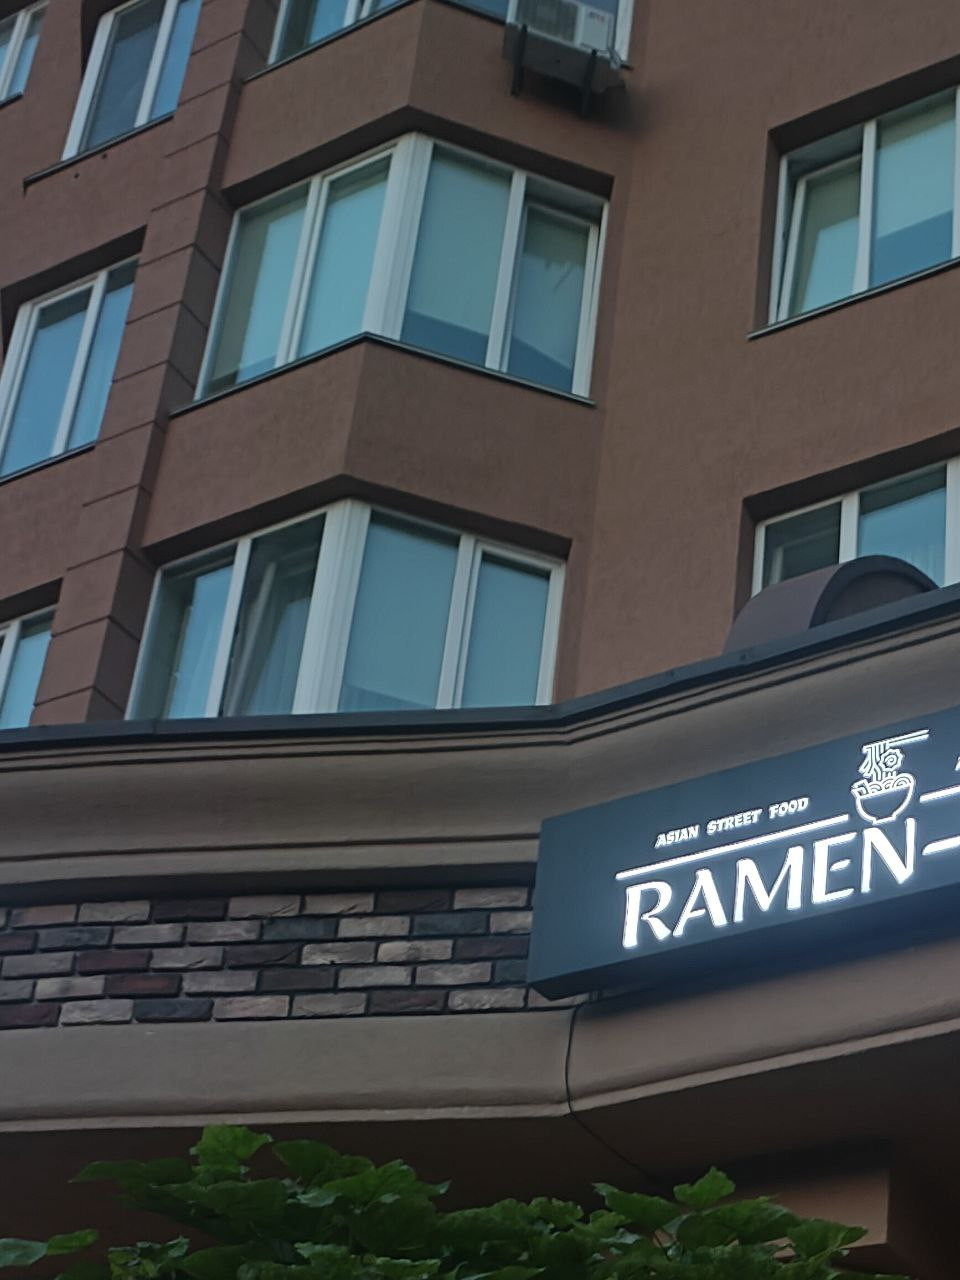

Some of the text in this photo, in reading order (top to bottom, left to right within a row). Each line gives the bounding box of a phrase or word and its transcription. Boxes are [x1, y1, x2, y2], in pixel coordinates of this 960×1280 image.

[654, 797, 809, 849] ASIAN STREET FOOD
